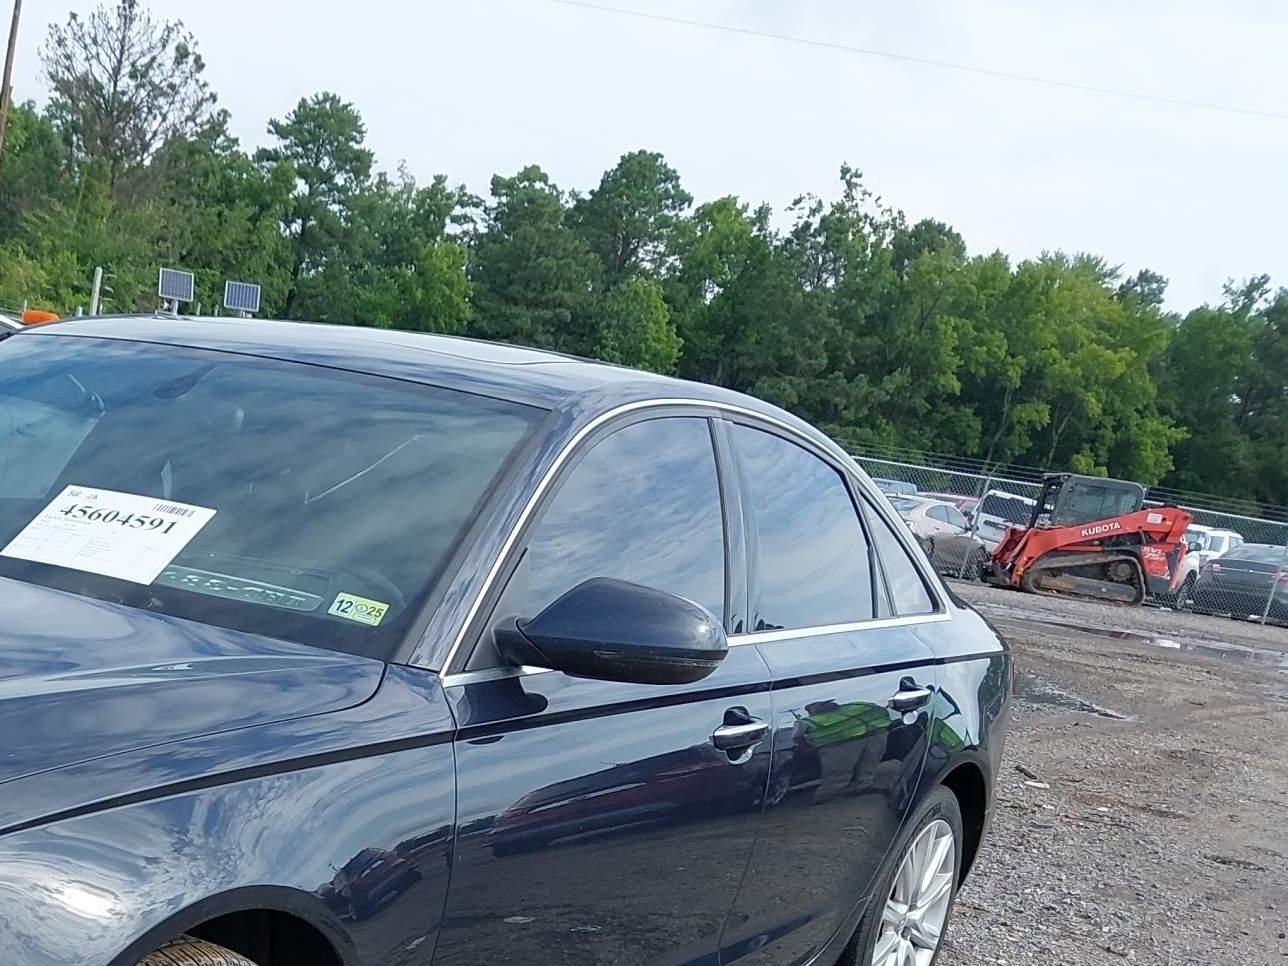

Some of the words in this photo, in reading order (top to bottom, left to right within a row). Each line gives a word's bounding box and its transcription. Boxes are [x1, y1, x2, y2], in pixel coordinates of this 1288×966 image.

[60, 503, 178, 534] 45604591
[1081, 522, 1121, 537] KUBOTA
[335, 599, 354, 613] 12
[366, 606, 384, 618] 25
